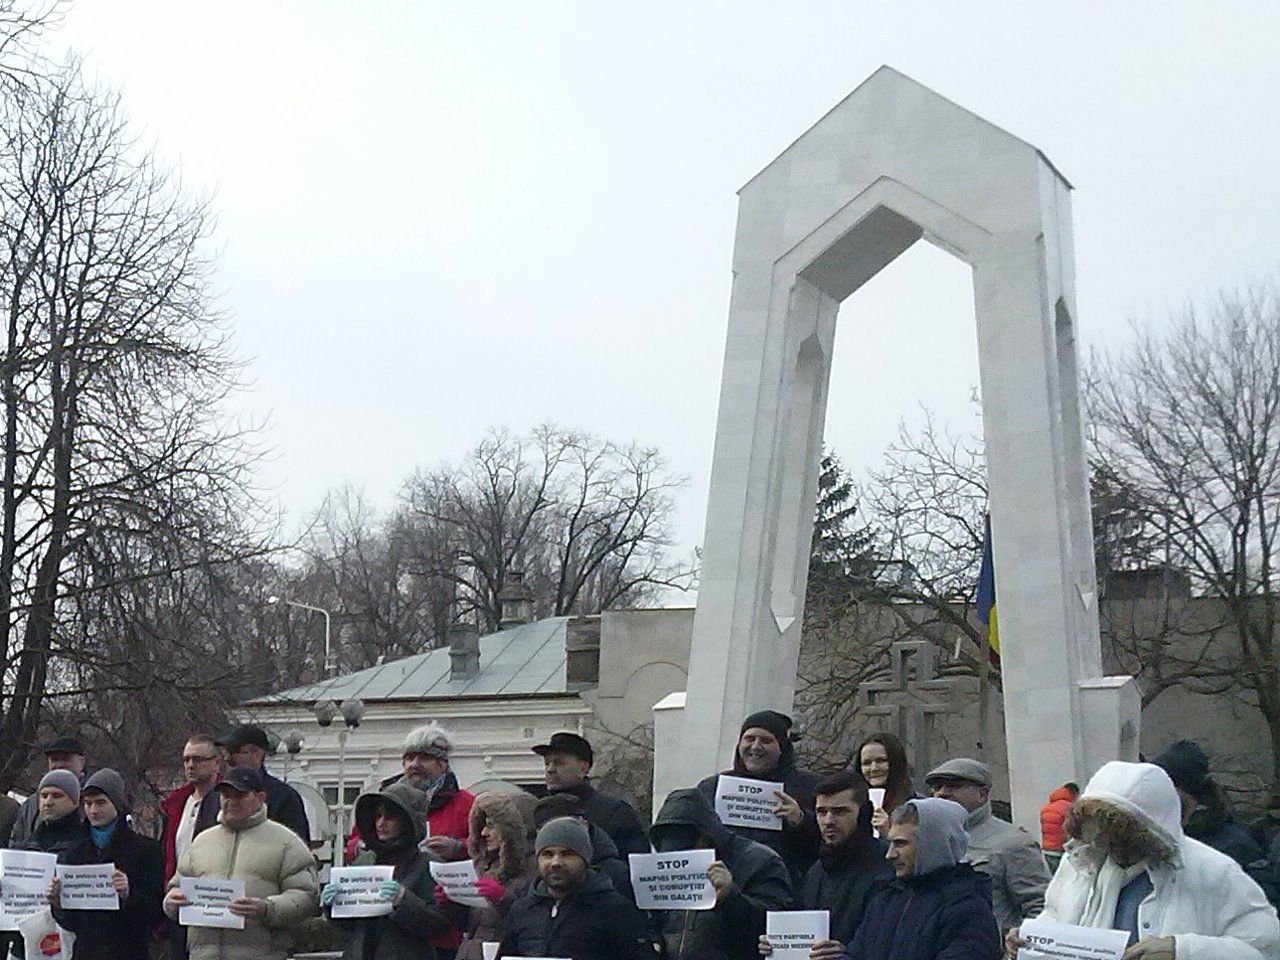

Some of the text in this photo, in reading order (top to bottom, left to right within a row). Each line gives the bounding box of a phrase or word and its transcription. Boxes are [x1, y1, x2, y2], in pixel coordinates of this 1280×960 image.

[738, 784, 763, 795] STOP
[657, 859, 689, 870] STOP
[1025, 934, 1055, 947] STOP
